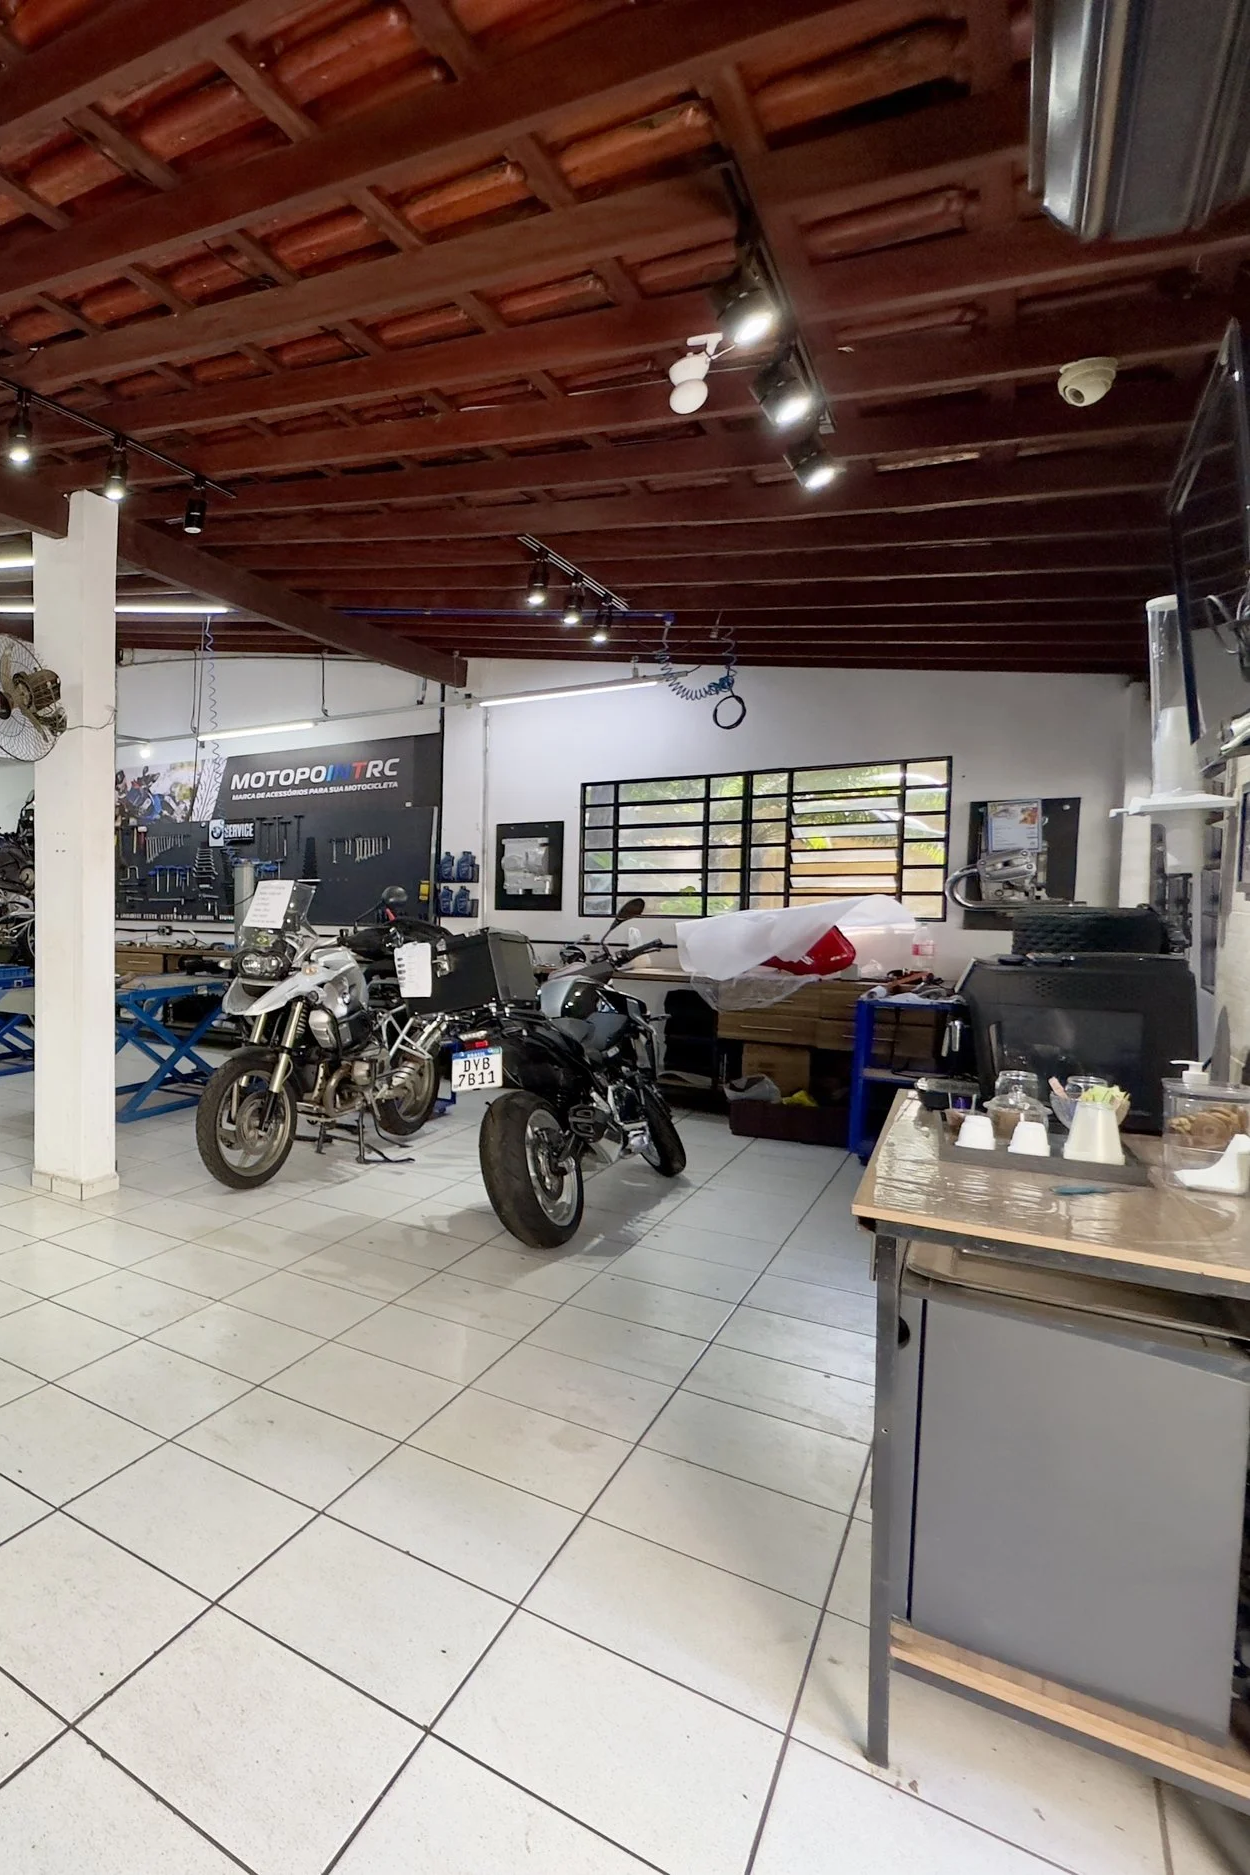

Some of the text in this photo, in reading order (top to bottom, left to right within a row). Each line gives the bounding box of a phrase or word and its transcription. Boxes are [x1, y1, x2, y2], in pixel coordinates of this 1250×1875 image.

[230, 757, 400, 790] MOTOPOINTRC
[232, 793, 255, 801] MARCA
[266, 788, 308, 798] ACESSÓRIOS
[309, 786, 328, 794] PARA
[329, 785, 343, 793] SUA
[344, 781, 398, 792] MOTOCICLETA
[463, 1057, 490, 1073] DYB
[458, 1070, 495, 1087] 7B11
